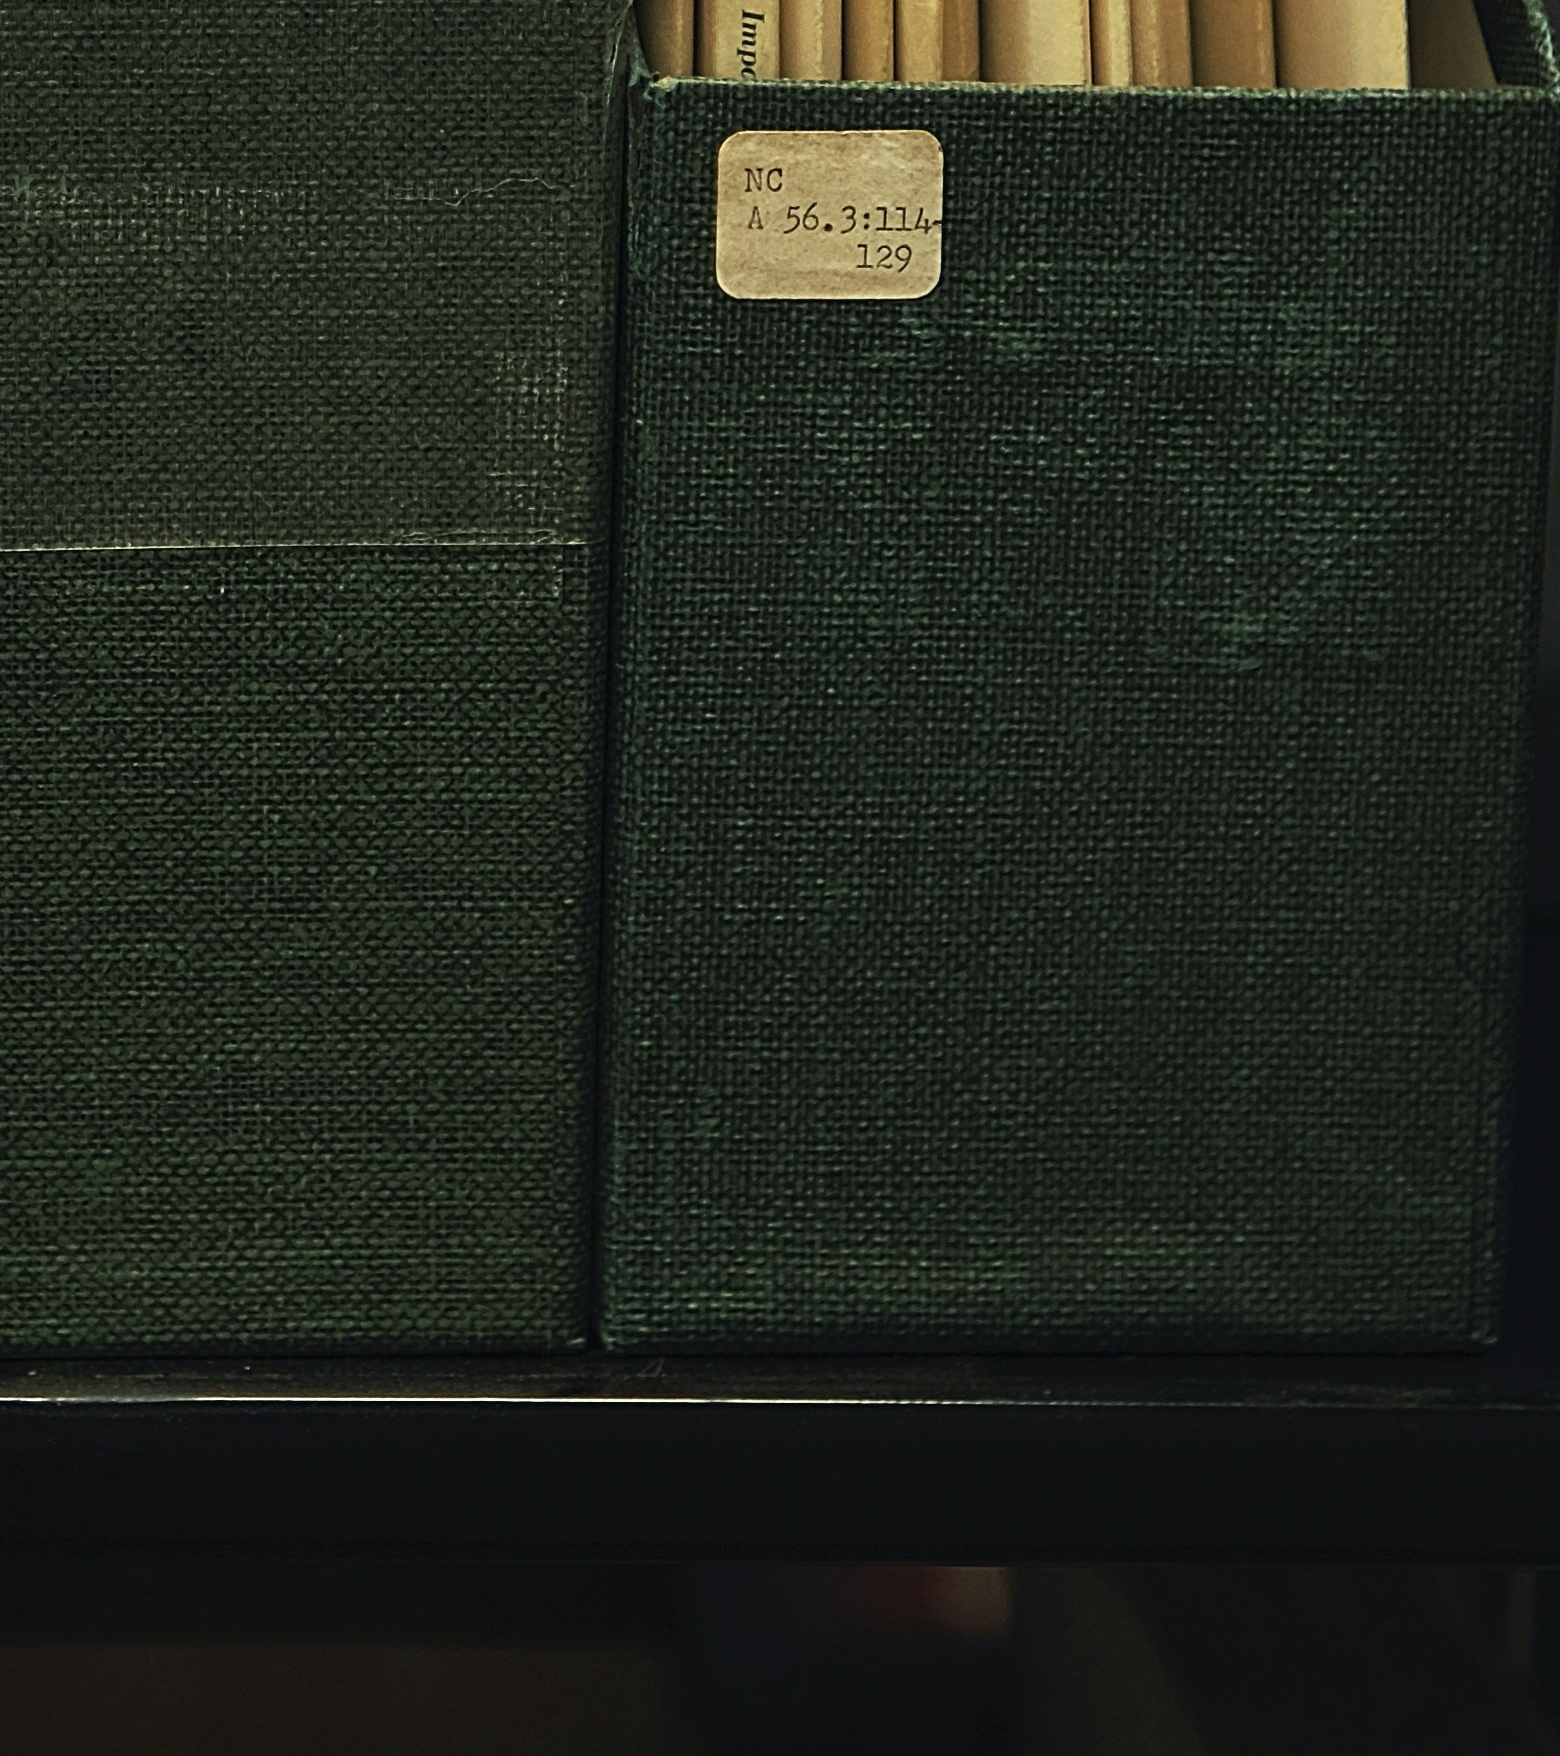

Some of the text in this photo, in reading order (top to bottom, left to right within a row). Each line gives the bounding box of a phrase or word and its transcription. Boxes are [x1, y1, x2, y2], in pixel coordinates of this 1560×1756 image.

[744, 167, 784, 193] NC
[747, 205, 764, 230] A
[855, 243, 914, 274] 129
